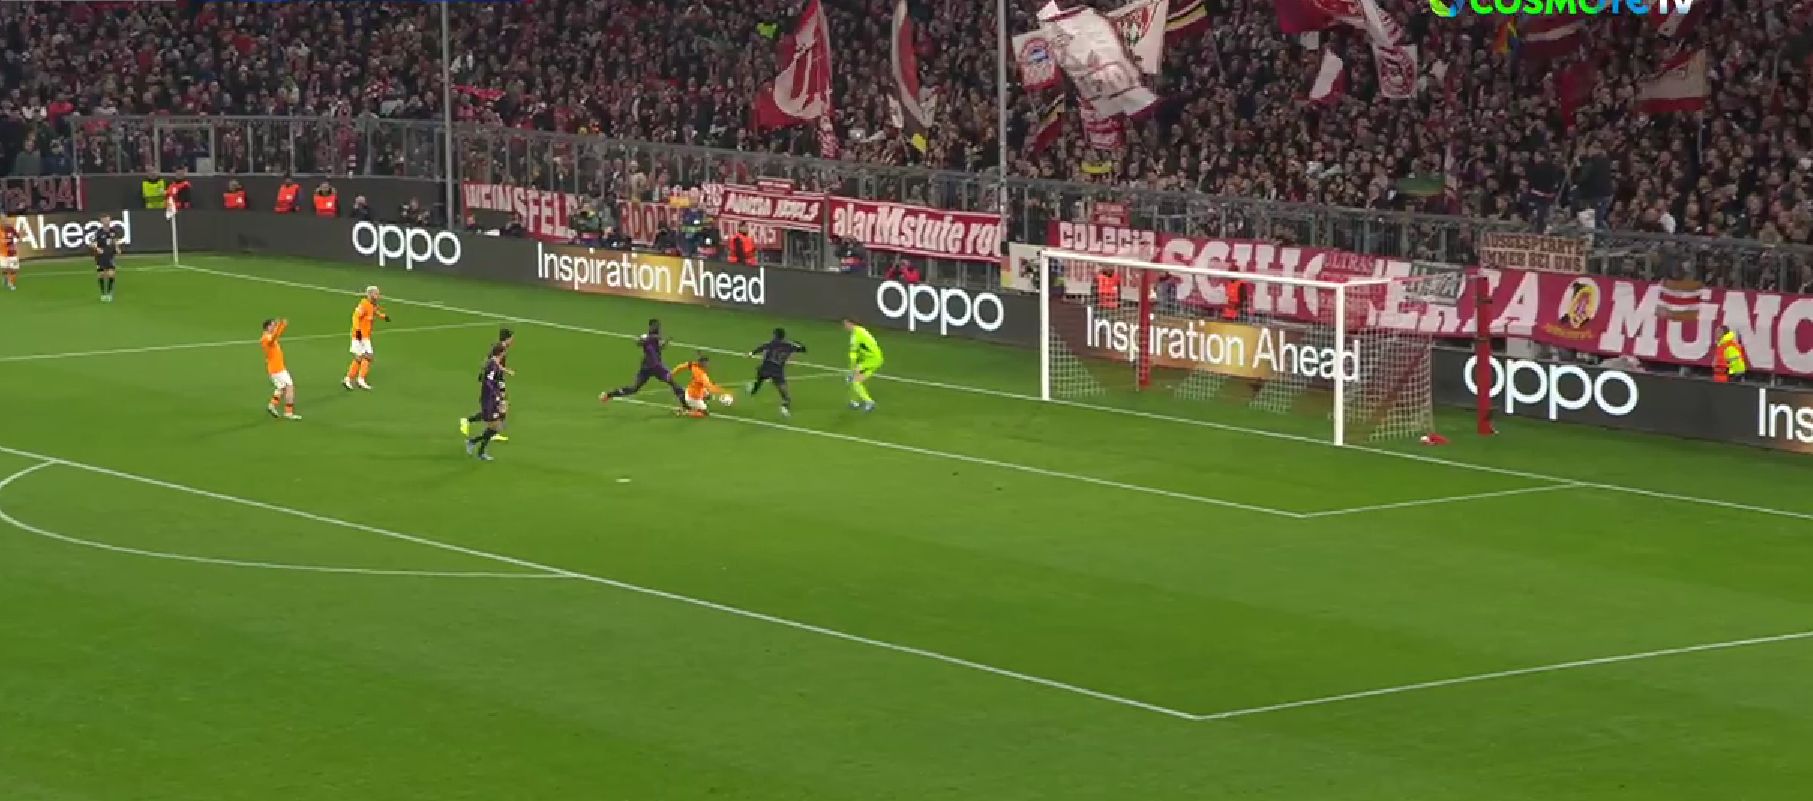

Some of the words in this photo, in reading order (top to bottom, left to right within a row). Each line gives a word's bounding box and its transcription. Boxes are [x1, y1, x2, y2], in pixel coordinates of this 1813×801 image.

[352, 221, 462, 270] oppo
[537, 241, 671, 293] Inspiration
[678, 259, 766, 304] Ahead
[876, 280, 1005, 335] oppo
[1086, 306, 1245, 366] Inspiration
[1252, 328, 1360, 382] Ahead
[1463, 355, 1639, 420] oppo
